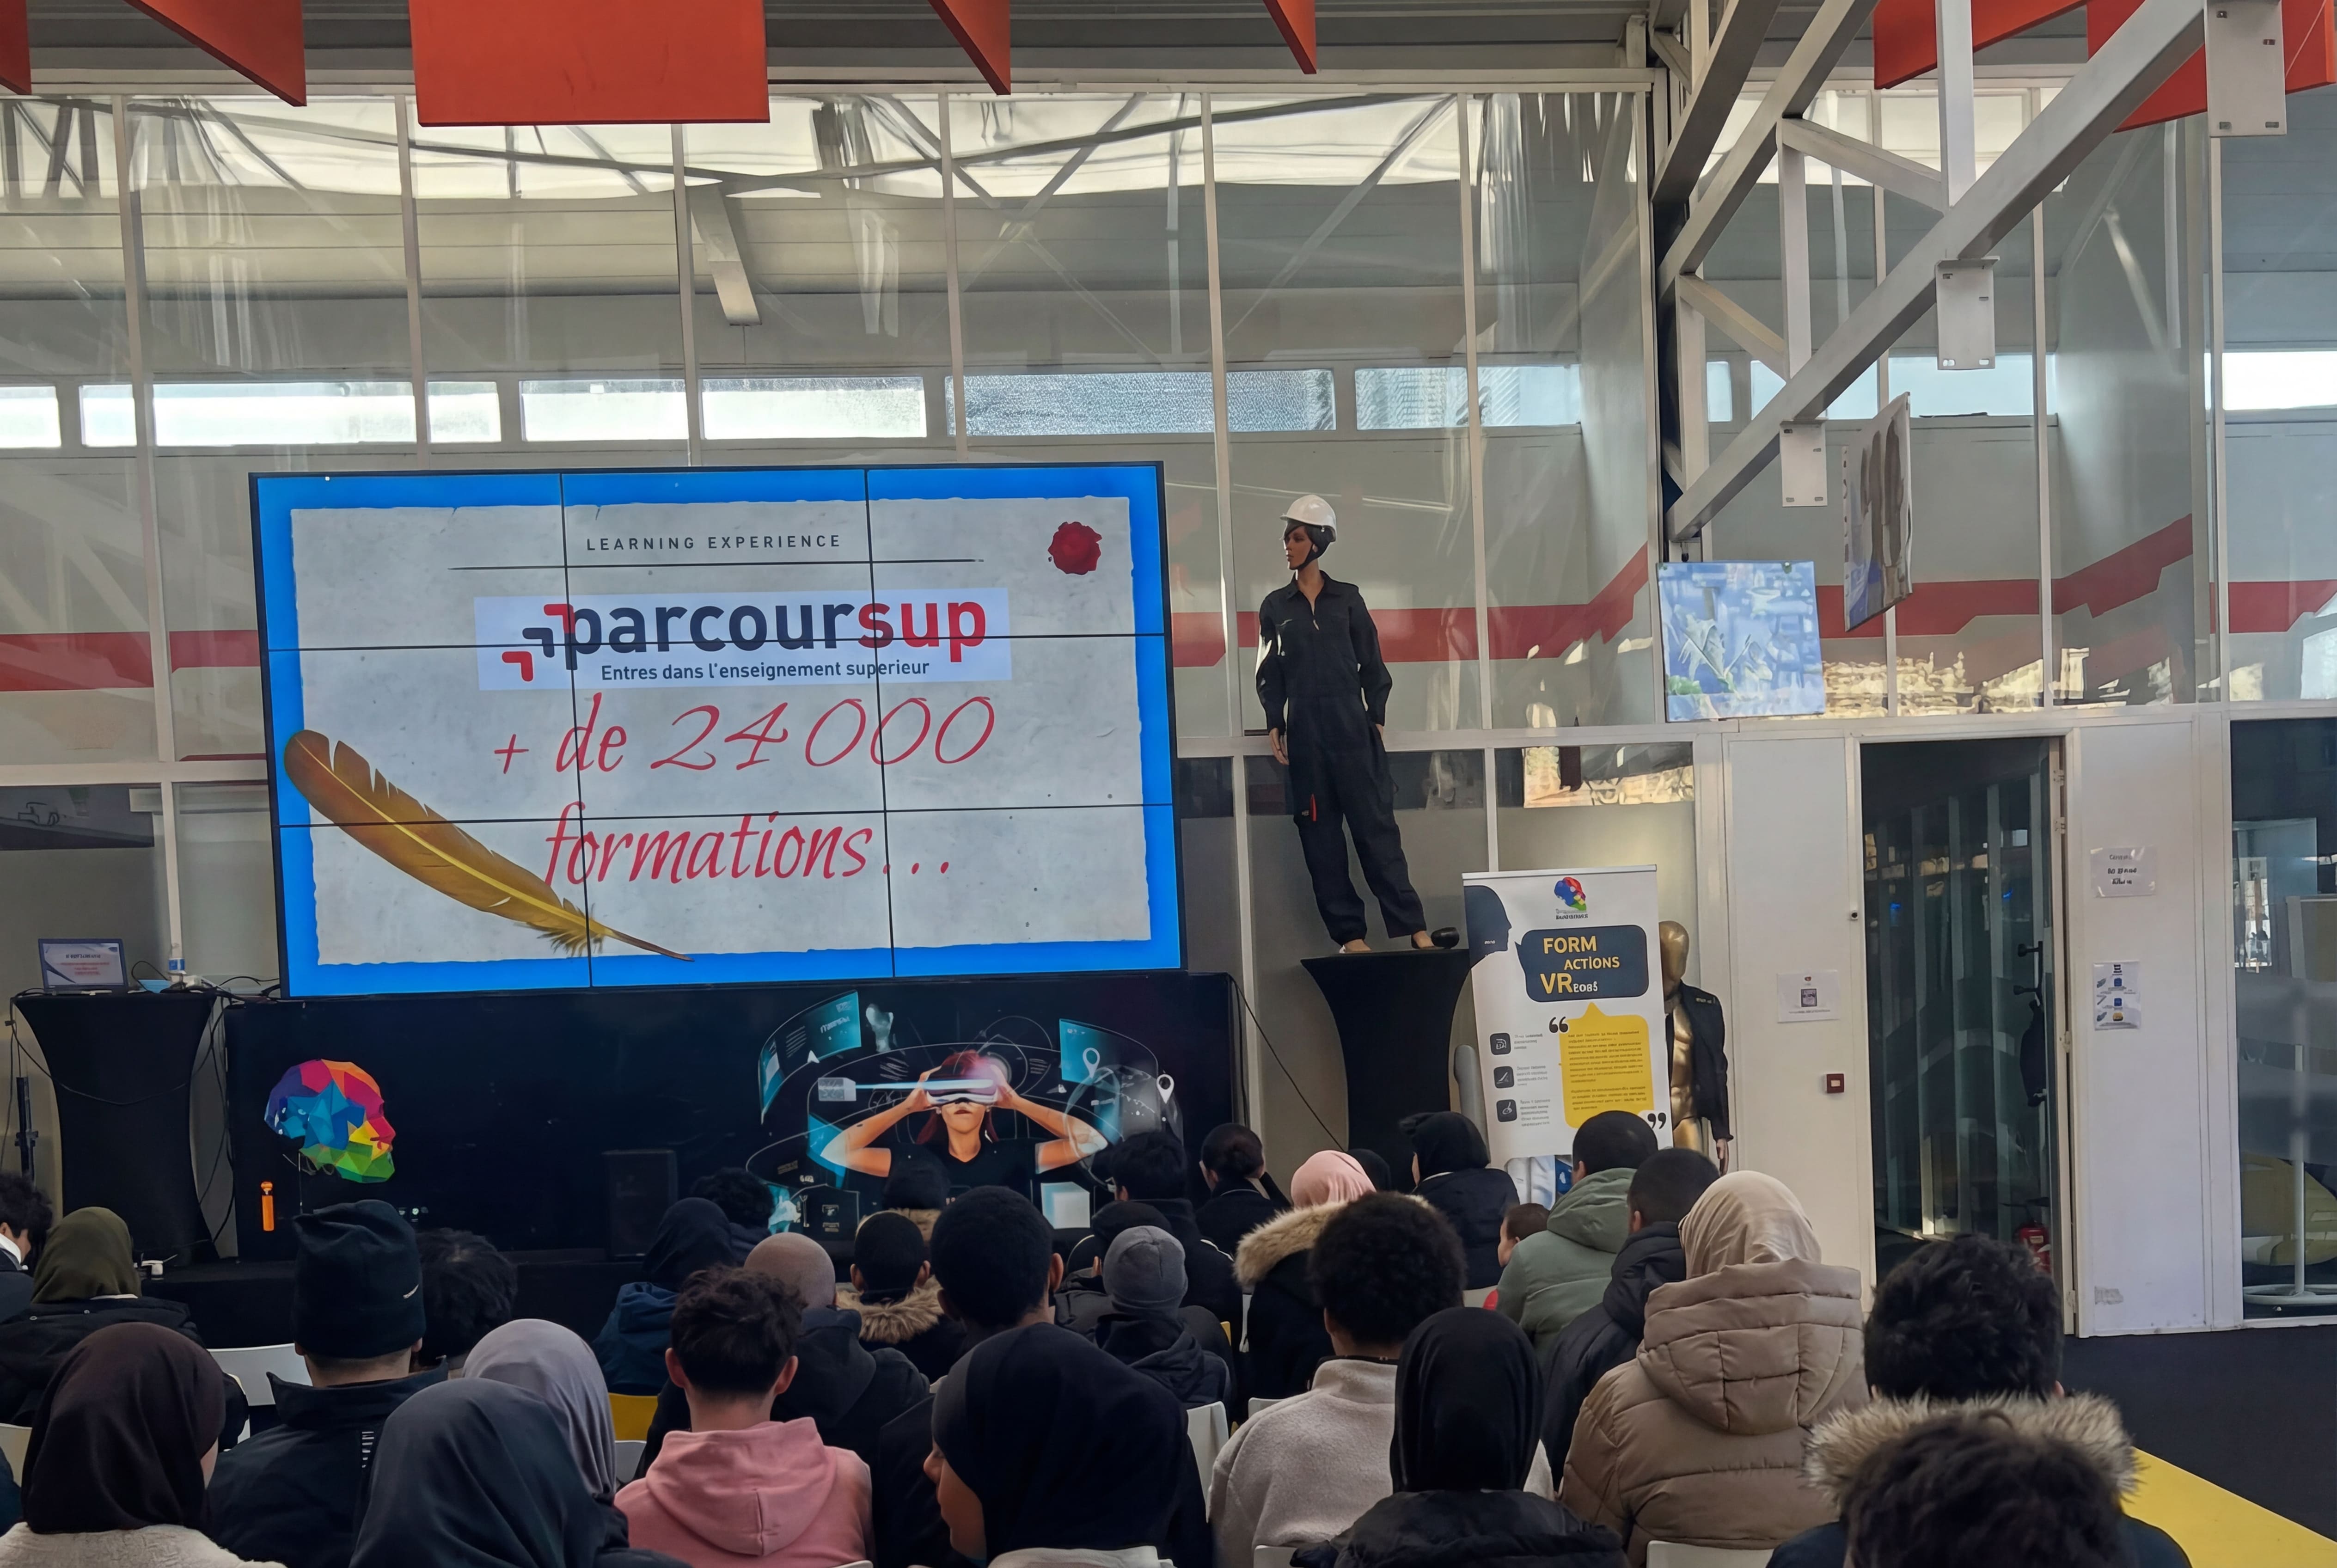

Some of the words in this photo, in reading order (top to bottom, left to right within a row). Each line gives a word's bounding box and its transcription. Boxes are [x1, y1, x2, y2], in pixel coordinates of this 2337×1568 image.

[587, 537, 694, 551] LEARNING
[708, 535, 840, 549] EXPERIENCE
[563, 601, 986, 670] parcoursup
[601, 665, 658, 680] Entres
[662, 664, 704, 679] dans
[709, 662, 841, 681] l'enseignement
[846, 659, 930, 679] superieur
[494, 734, 529, 774] +
[556, 692, 627, 772] de
[1543, 935, 1597, 955] FORM
